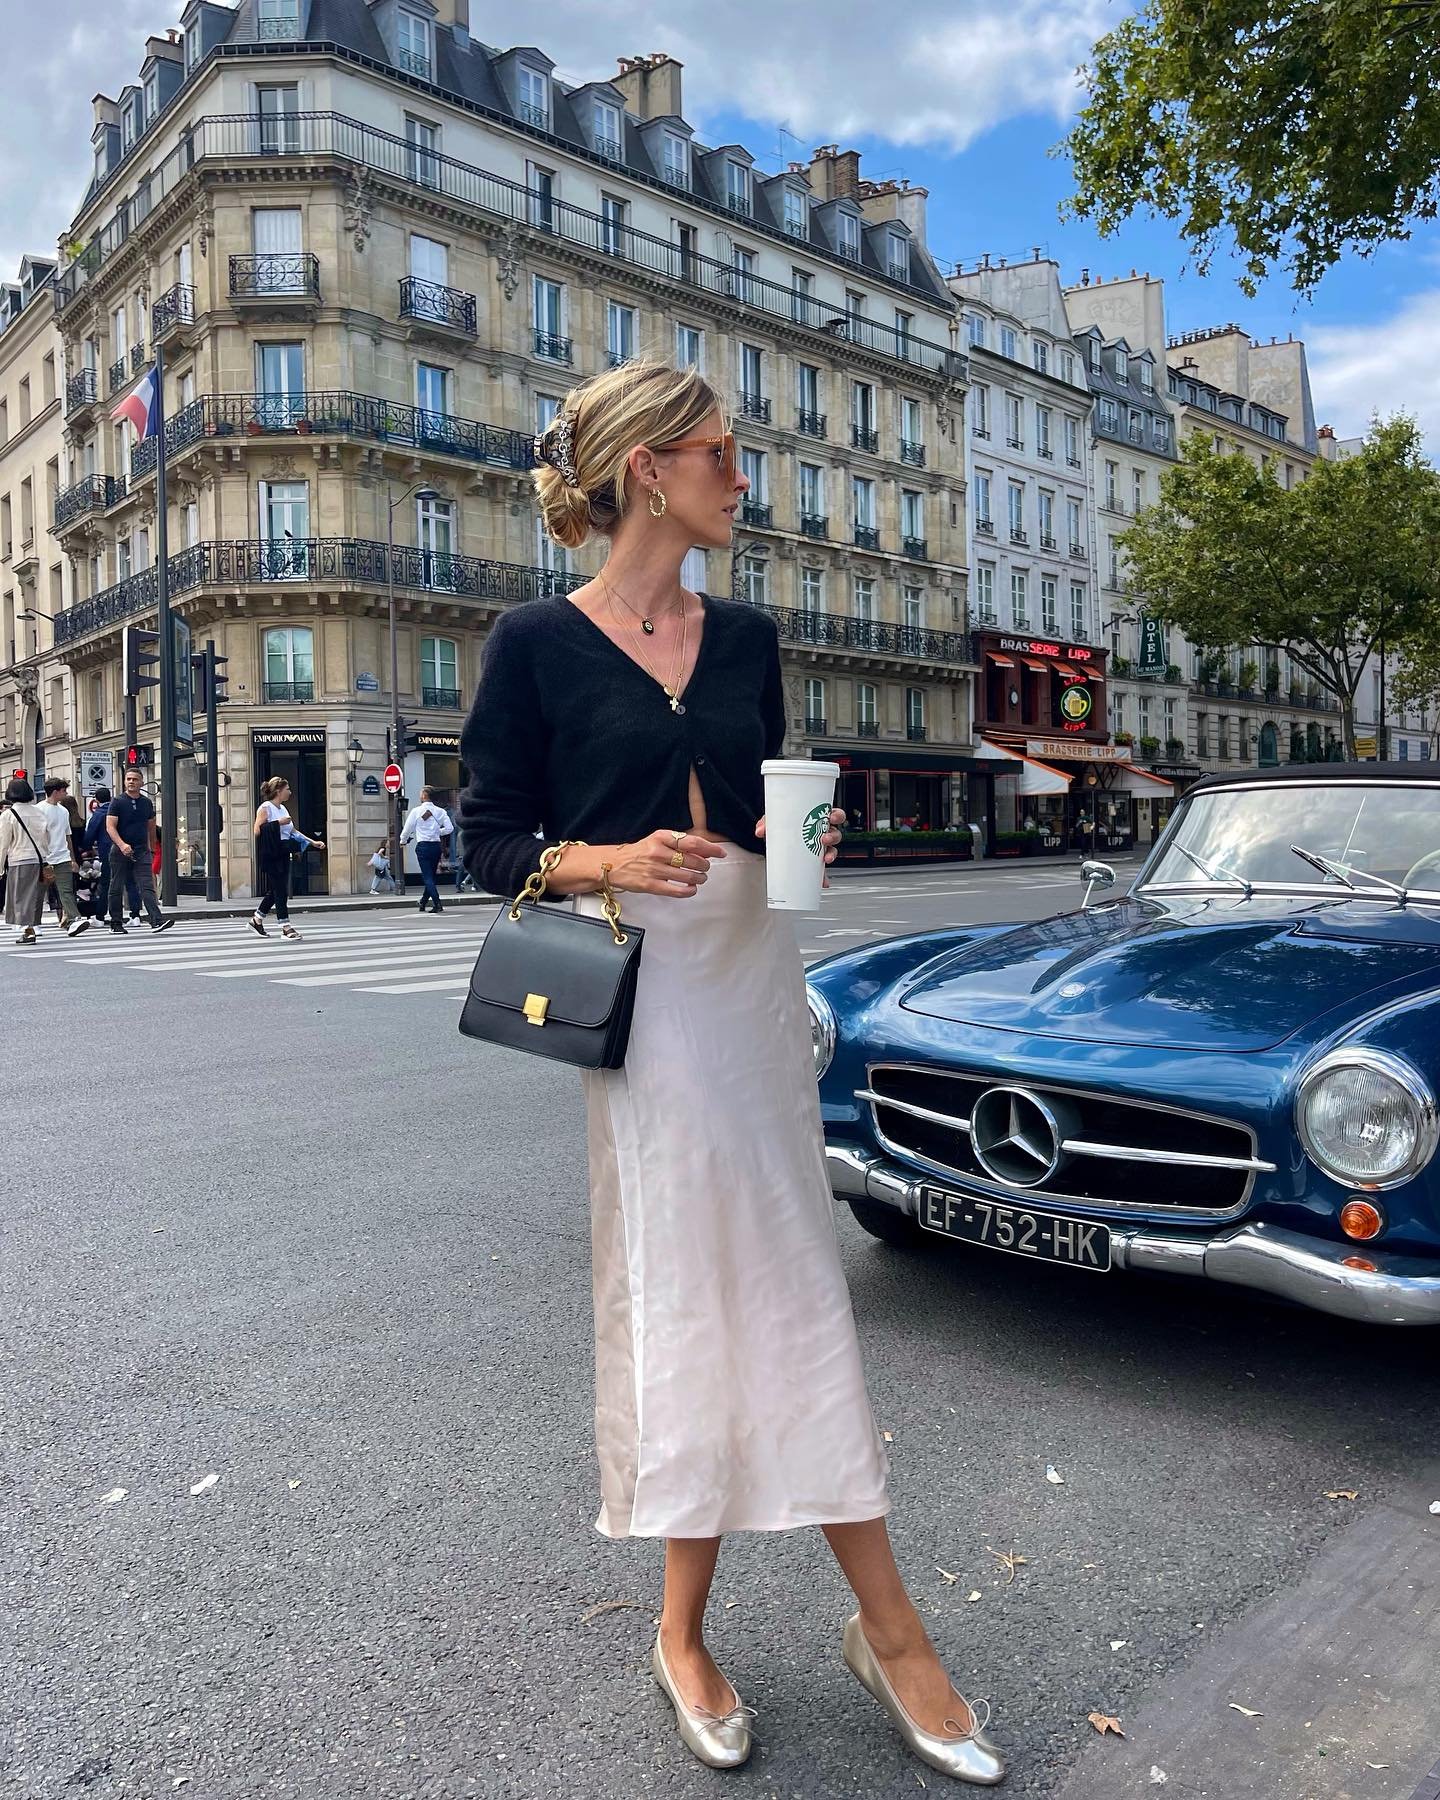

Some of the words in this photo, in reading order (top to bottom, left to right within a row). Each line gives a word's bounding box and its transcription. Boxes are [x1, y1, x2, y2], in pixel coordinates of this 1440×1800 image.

[1146, 618, 1156, 663] OTEL
[1000, 639, 1060, 657] BRASSERIE
[1068, 648, 1091, 661] LIPP
[1064, 675, 1087, 686] LIPP
[1064, 722, 1086, 732] LIPP
[254, 734, 287, 743] EMPORIO
[295, 734, 324, 742] ARMANI
[1043, 744, 1092, 757] BRASSERIE
[1097, 747, 1116, 758] LIPP
[1043, 837, 1061, 847] LIPP
[1107, 837, 1123, 846] LIPP
[926, 1190, 1098, 1265] EF-752-HK
